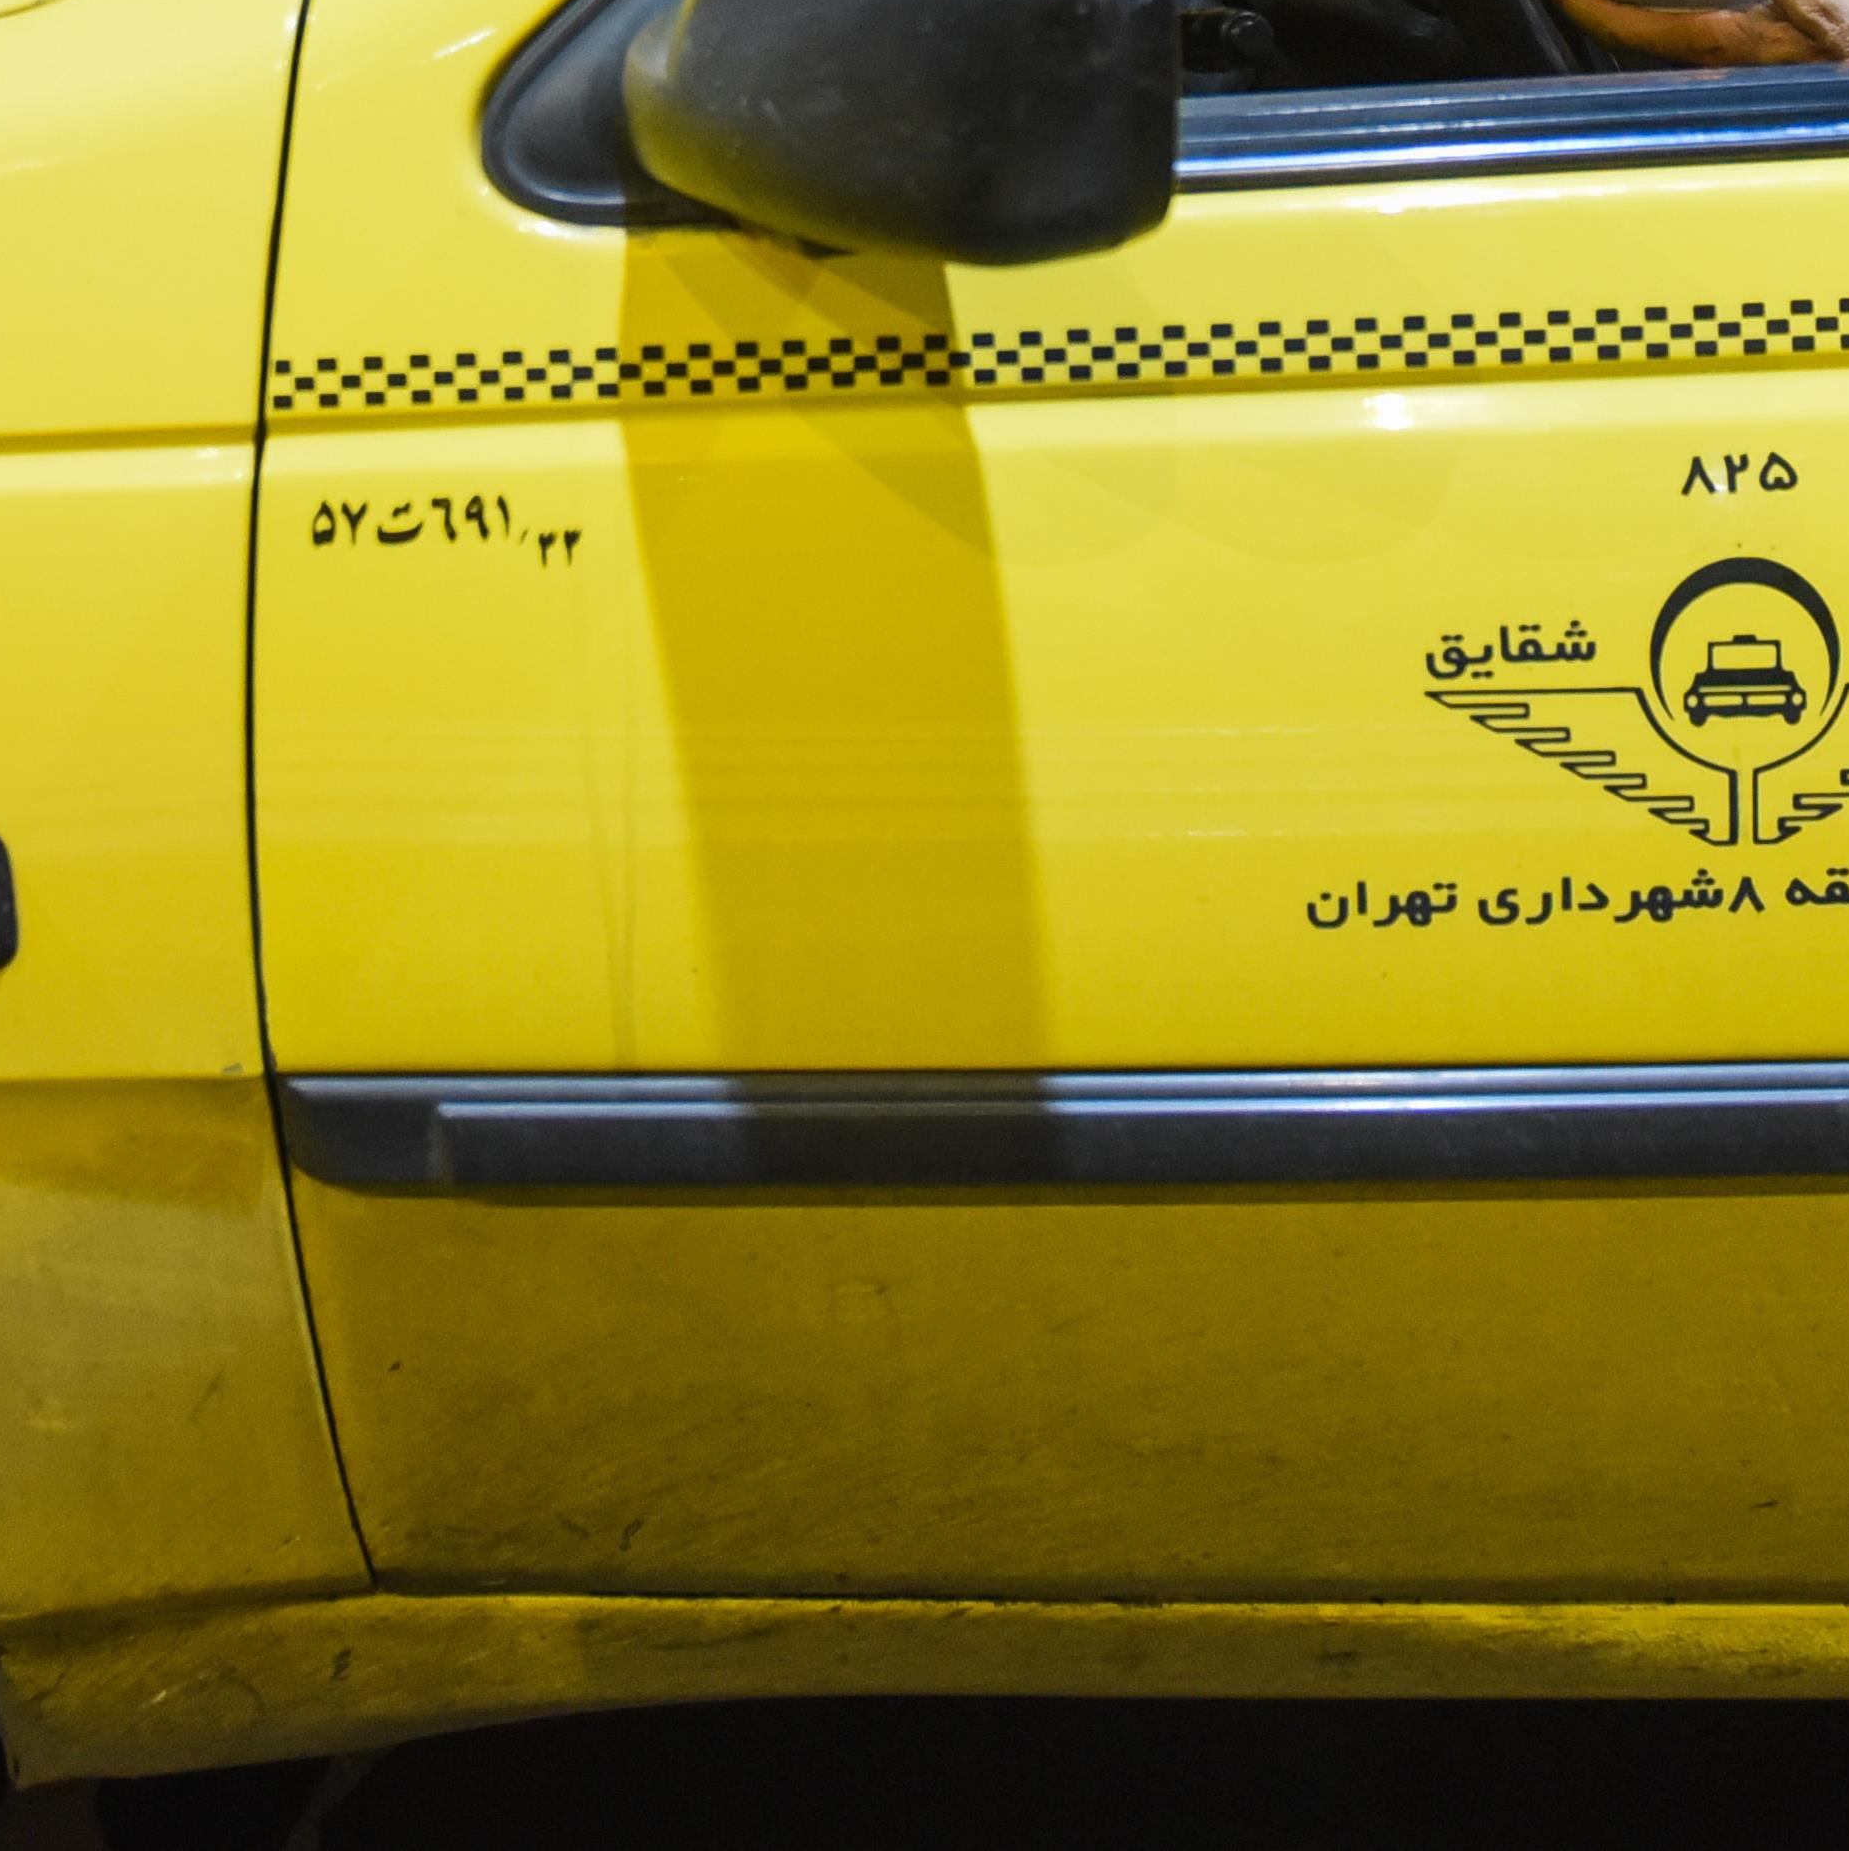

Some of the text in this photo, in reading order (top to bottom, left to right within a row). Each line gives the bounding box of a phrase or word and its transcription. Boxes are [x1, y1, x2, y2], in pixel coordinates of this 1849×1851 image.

[1680, 450, 1799, 497] ۸۲۵
[1424, 618, 1598, 682] شقایق
[1305, 880, 1459, 930] تهران
